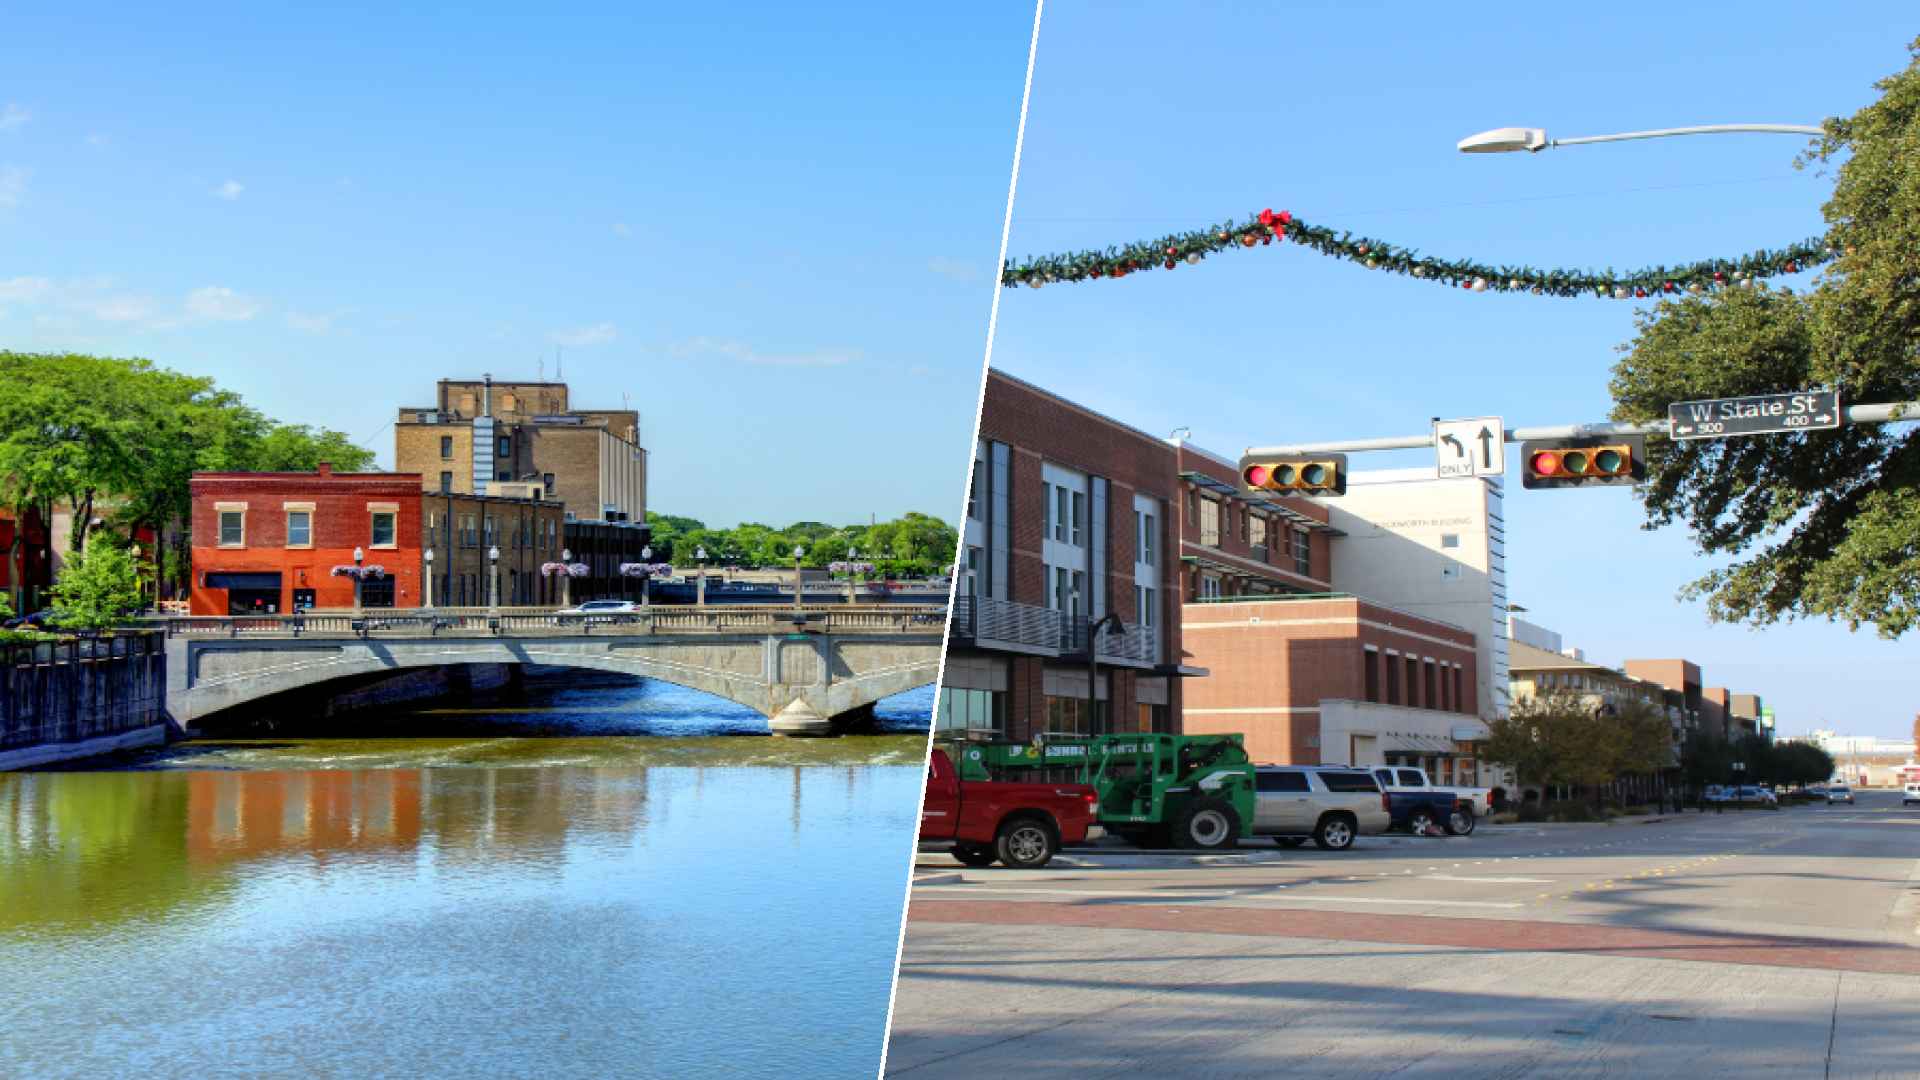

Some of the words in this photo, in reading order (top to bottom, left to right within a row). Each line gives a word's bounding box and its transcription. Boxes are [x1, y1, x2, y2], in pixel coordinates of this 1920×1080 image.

[1689, 404, 1713, 422] W
[1720, 400, 1784, 420] State
[1791, 395, 1817, 414] St
[1783, 415, 1810, 427] 400
[1697, 421, 1724, 434] 500
[1440, 463, 1472, 474] ONLY
